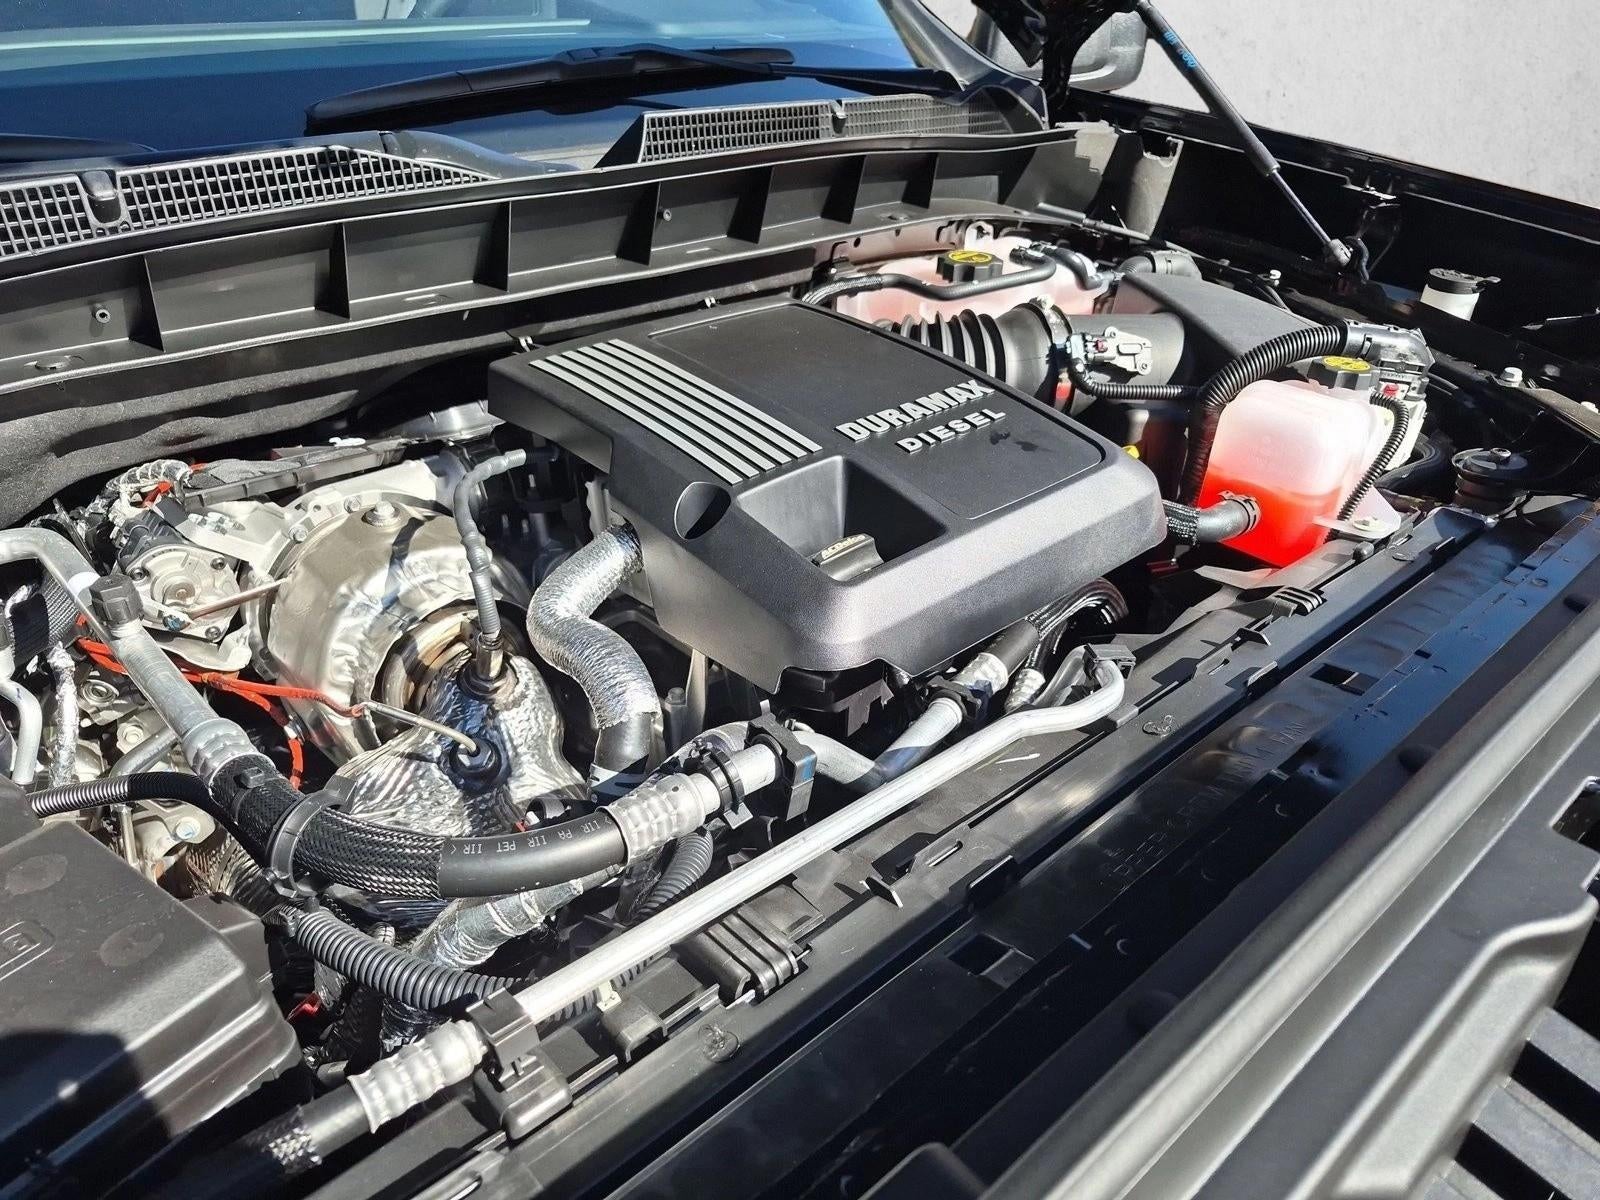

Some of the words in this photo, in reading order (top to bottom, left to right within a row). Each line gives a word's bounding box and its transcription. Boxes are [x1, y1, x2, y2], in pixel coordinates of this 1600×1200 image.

[835, 379, 995, 442] DURAMAX
[896, 408, 1006, 454] DIESEL
[496, 840, 516, 853] PET
[558, 828, 574, 841] PA
